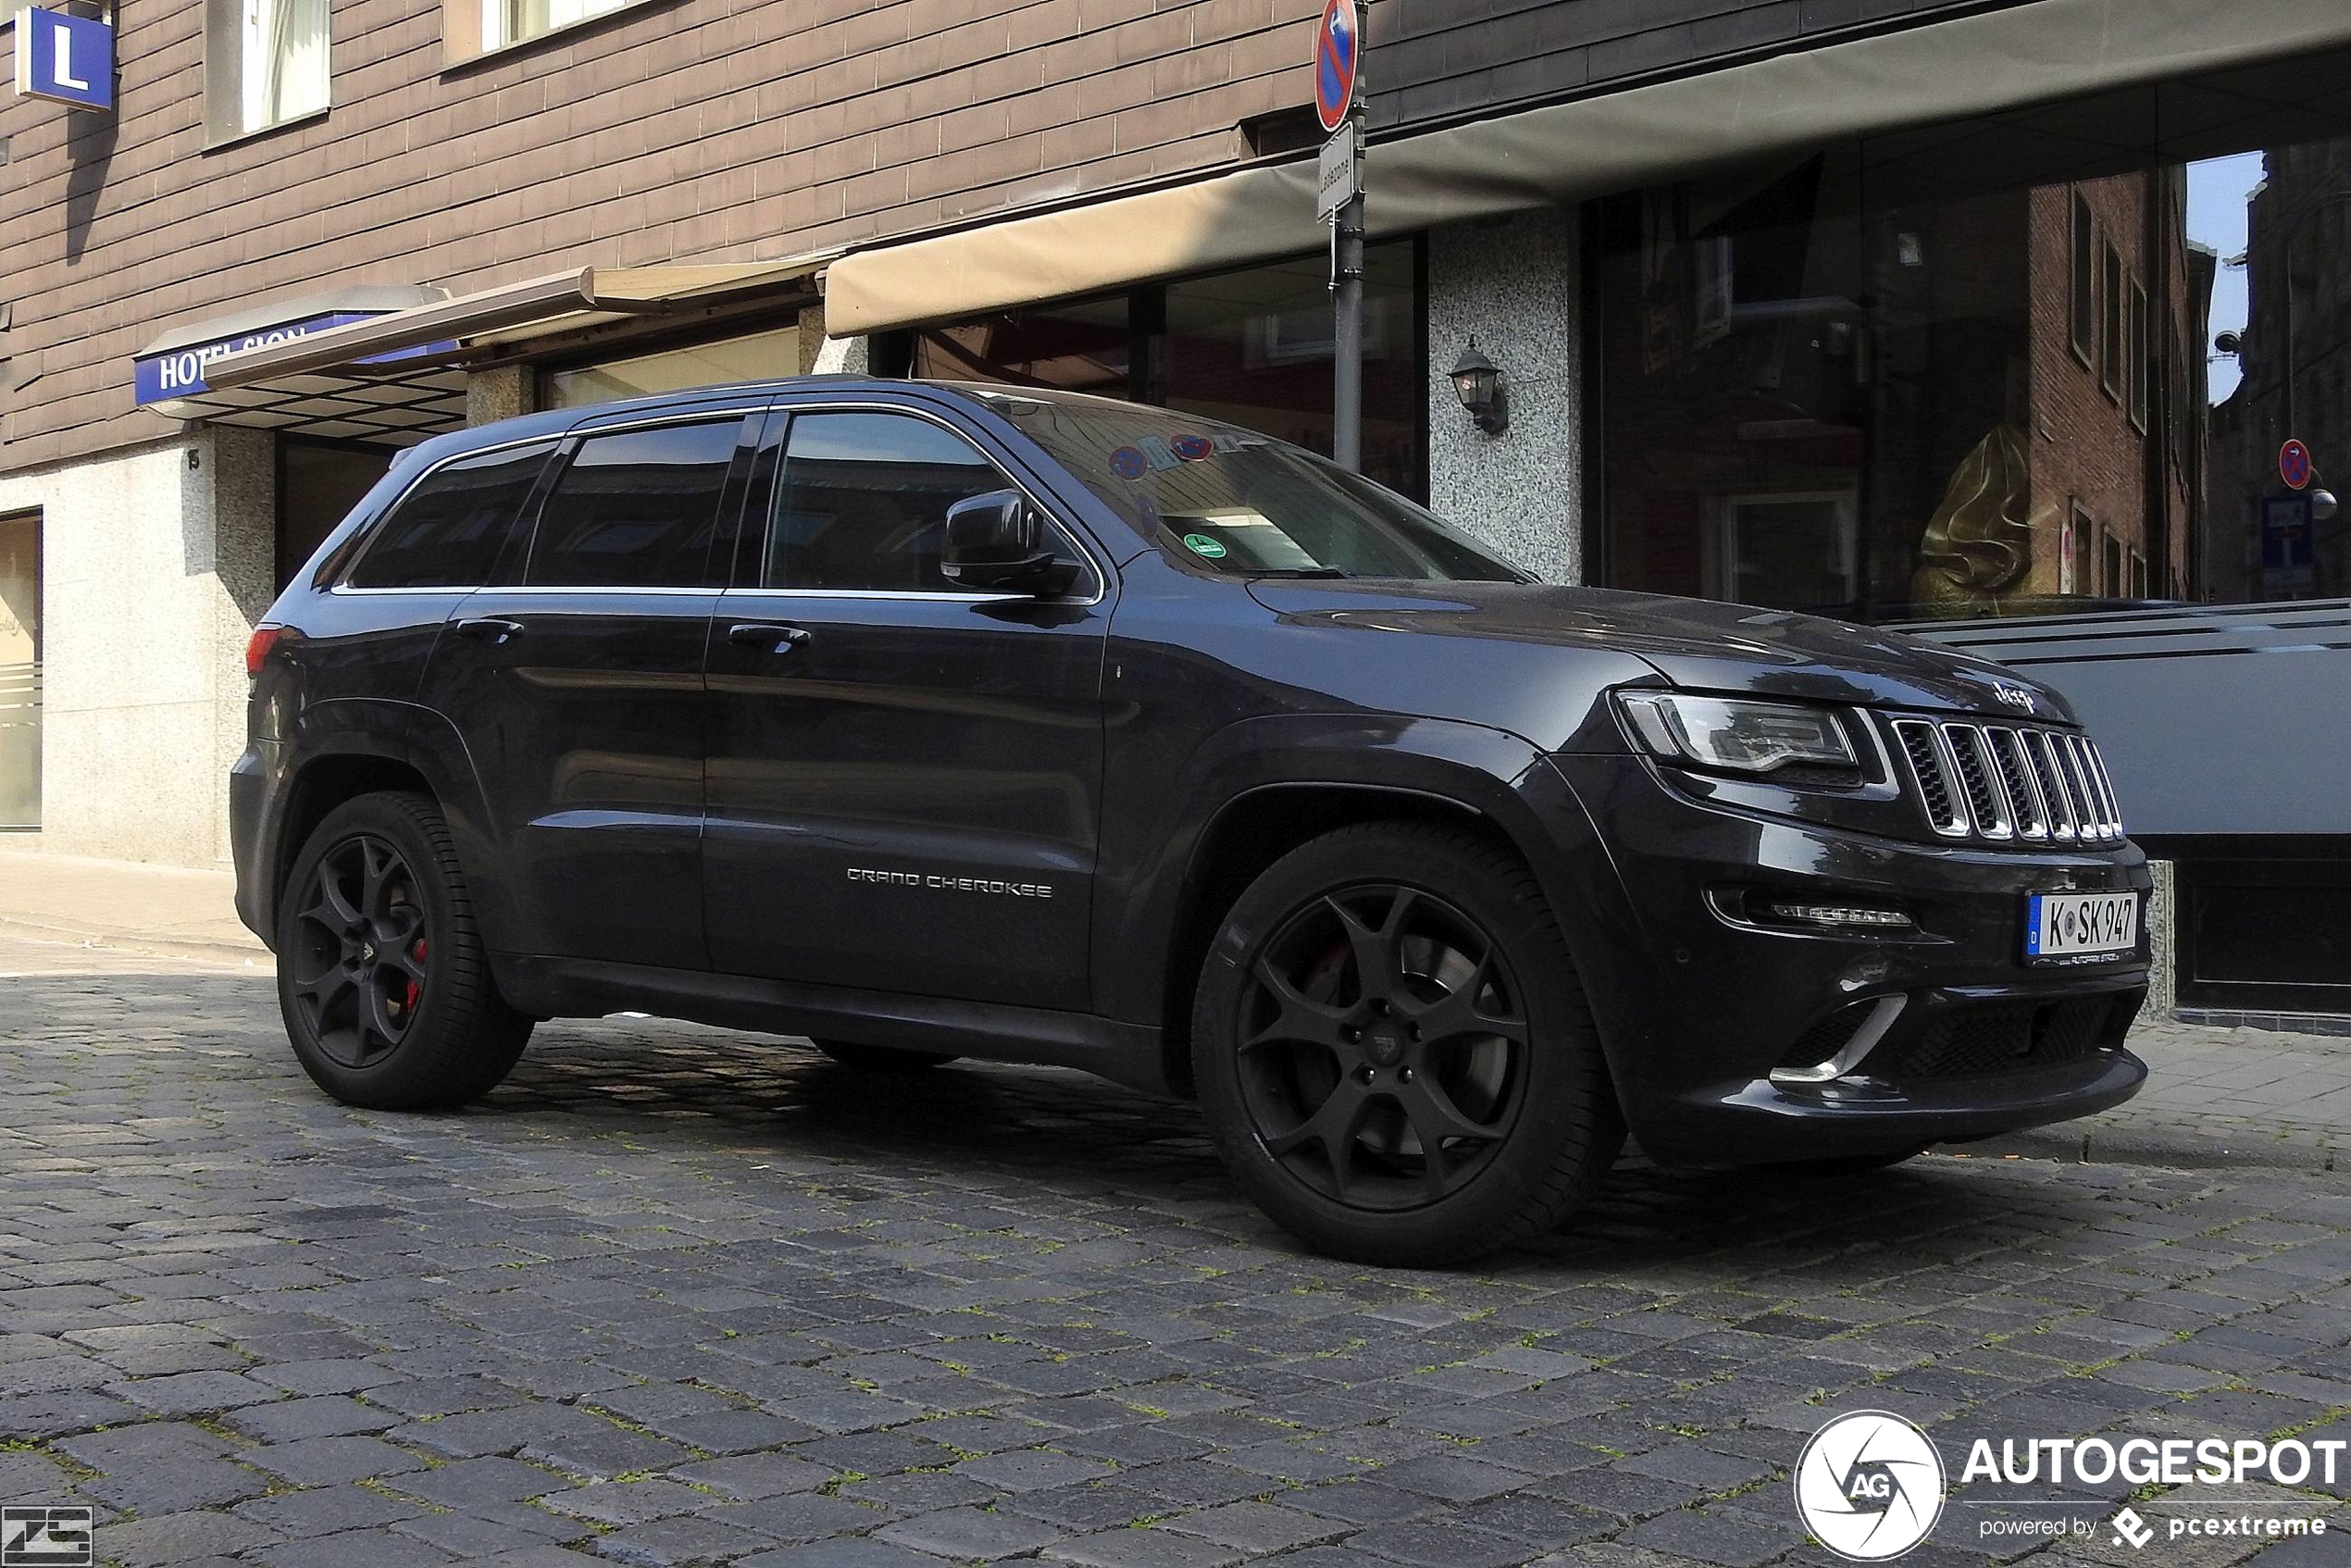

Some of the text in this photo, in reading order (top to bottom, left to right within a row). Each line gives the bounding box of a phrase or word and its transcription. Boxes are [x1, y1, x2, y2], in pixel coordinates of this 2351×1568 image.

[53, 24, 89, 92] L
[159, 343, 230, 390] HOT
[1992, 681, 2034, 715] Jeep
[847, 867, 1052, 898] GRAND CHEROKEE
[2049, 902, 2064, 947] K
